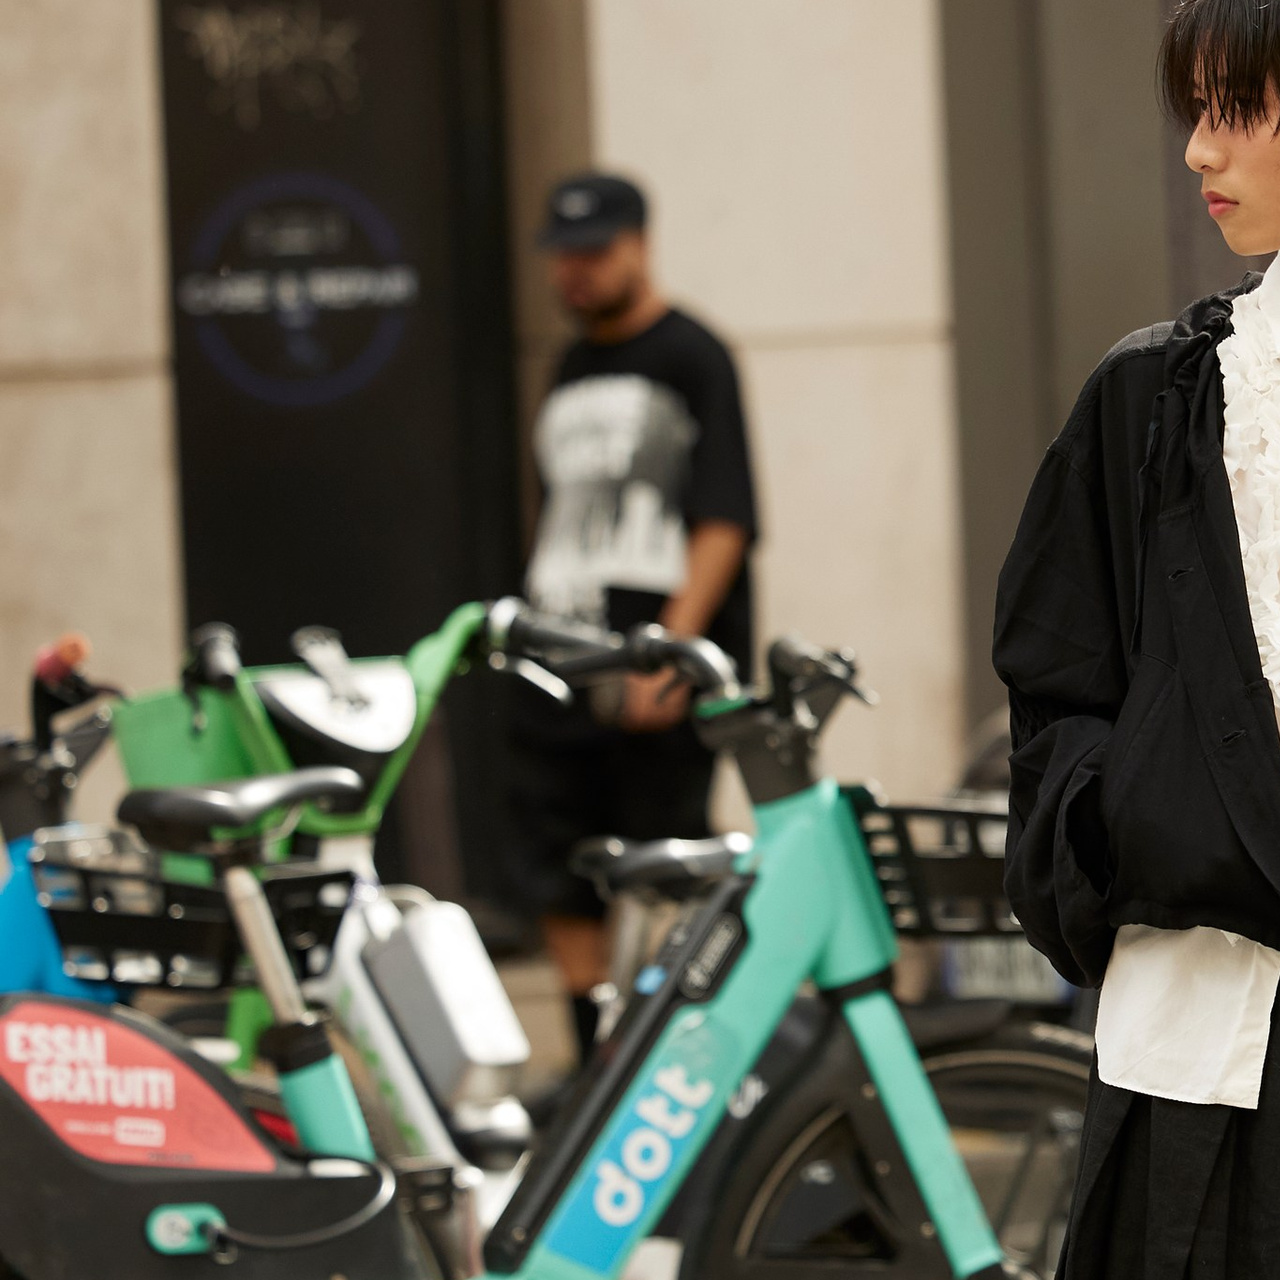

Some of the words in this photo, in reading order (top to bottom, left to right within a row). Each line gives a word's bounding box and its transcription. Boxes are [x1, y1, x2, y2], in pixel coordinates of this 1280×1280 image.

[6, 1022, 107, 1066] ESSAI
[26, 1063, 176, 1110] GRATUIT!
[593, 1063, 714, 1227] dott
